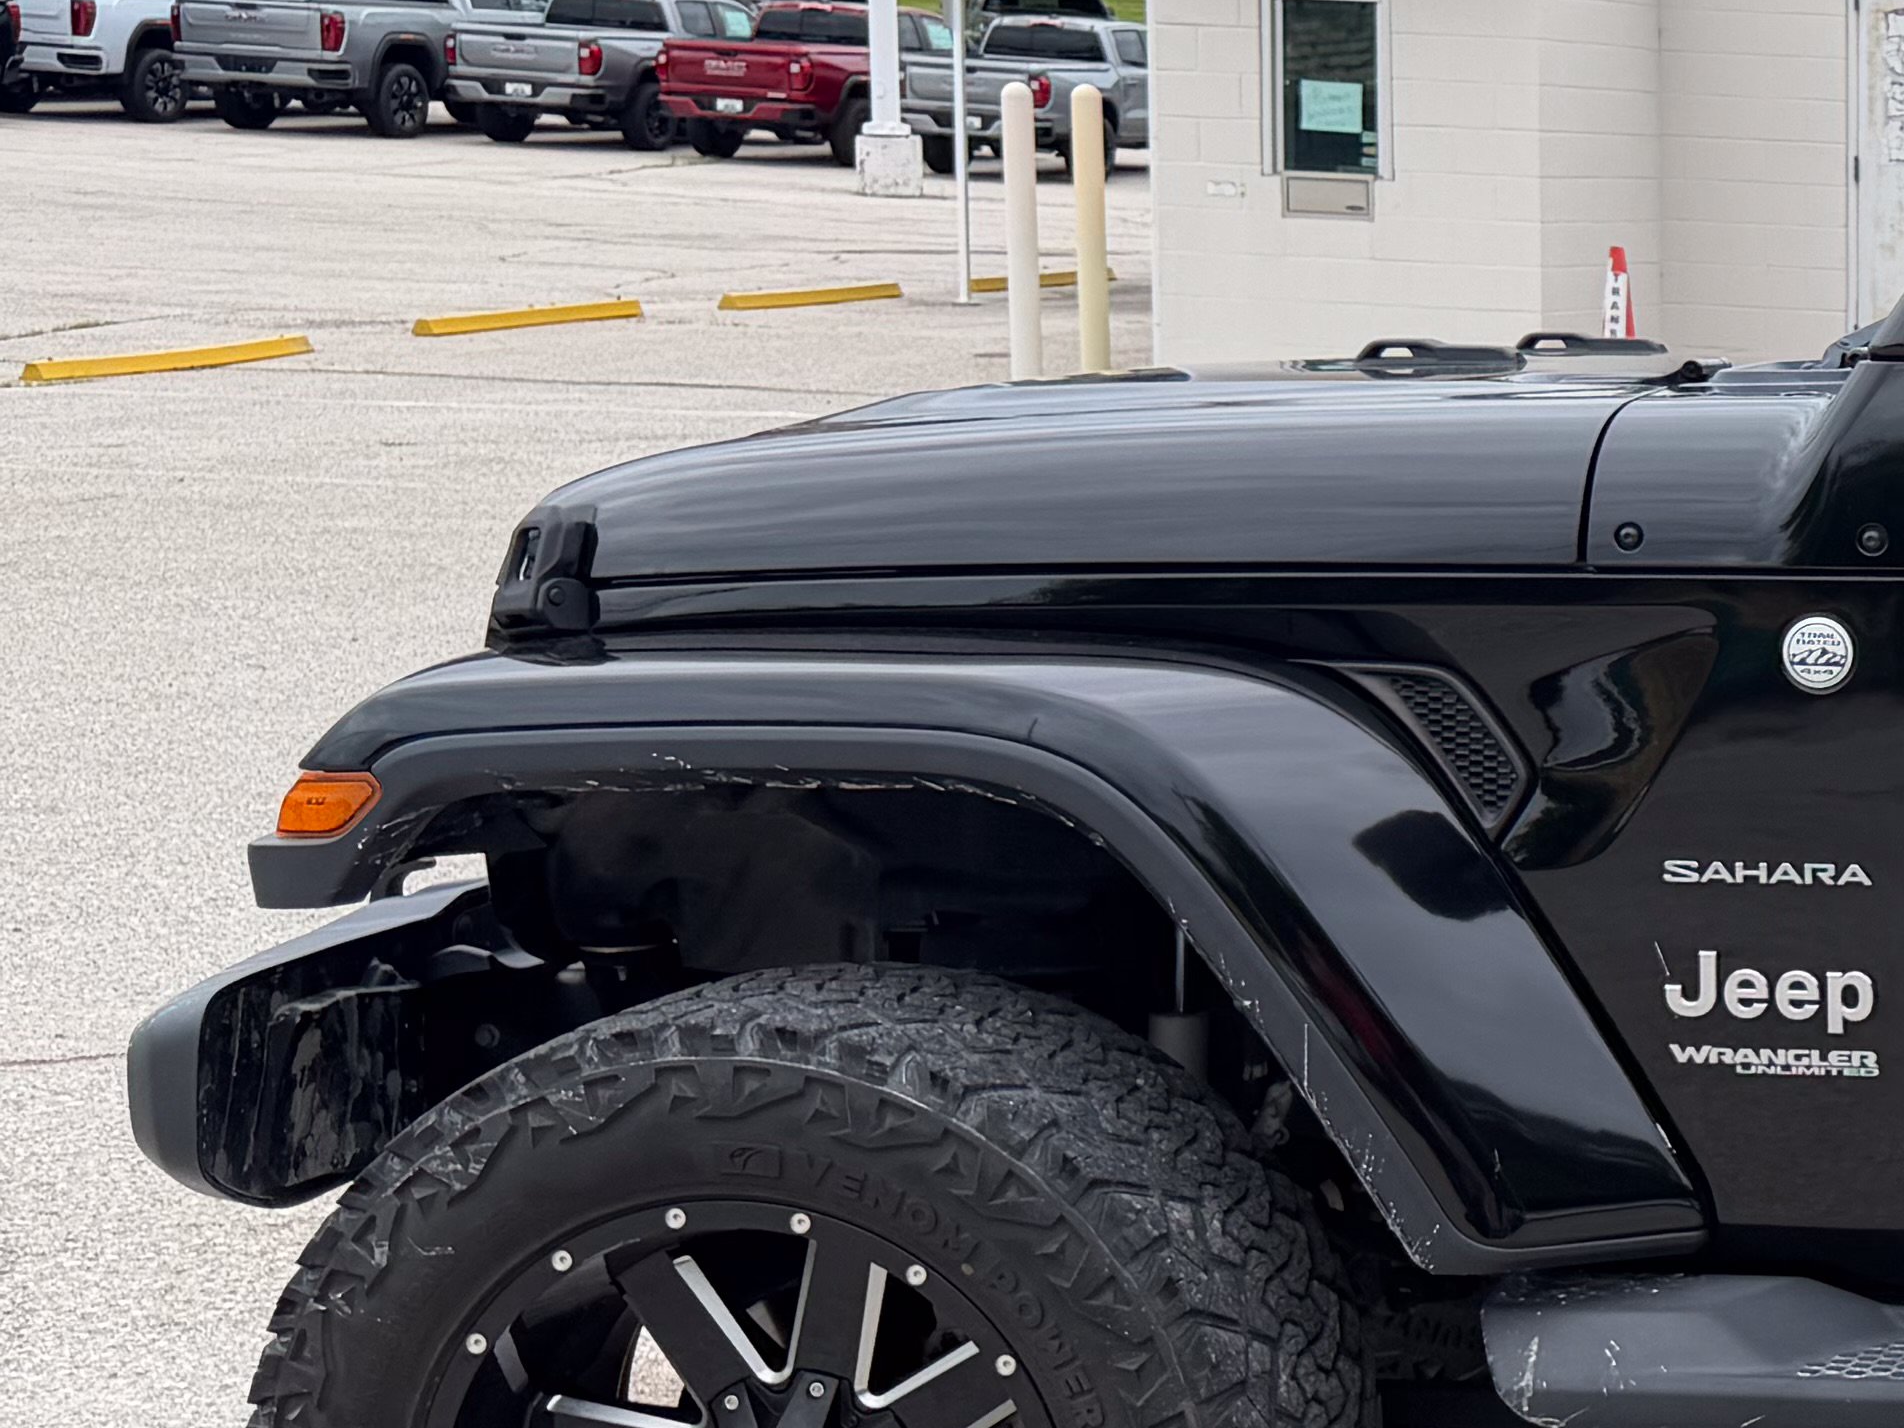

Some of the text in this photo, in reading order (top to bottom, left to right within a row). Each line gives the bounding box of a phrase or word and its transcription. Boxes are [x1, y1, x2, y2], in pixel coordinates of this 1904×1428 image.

[1662, 859, 1873, 886] SAHARA
[1663, 950, 1875, 1035] Jeep
[1668, 1043, 1879, 1069] WRANGLER
[1735, 1064, 1880, 1078] UNLIMITED
[798, 1152, 991, 1273] VENOM
